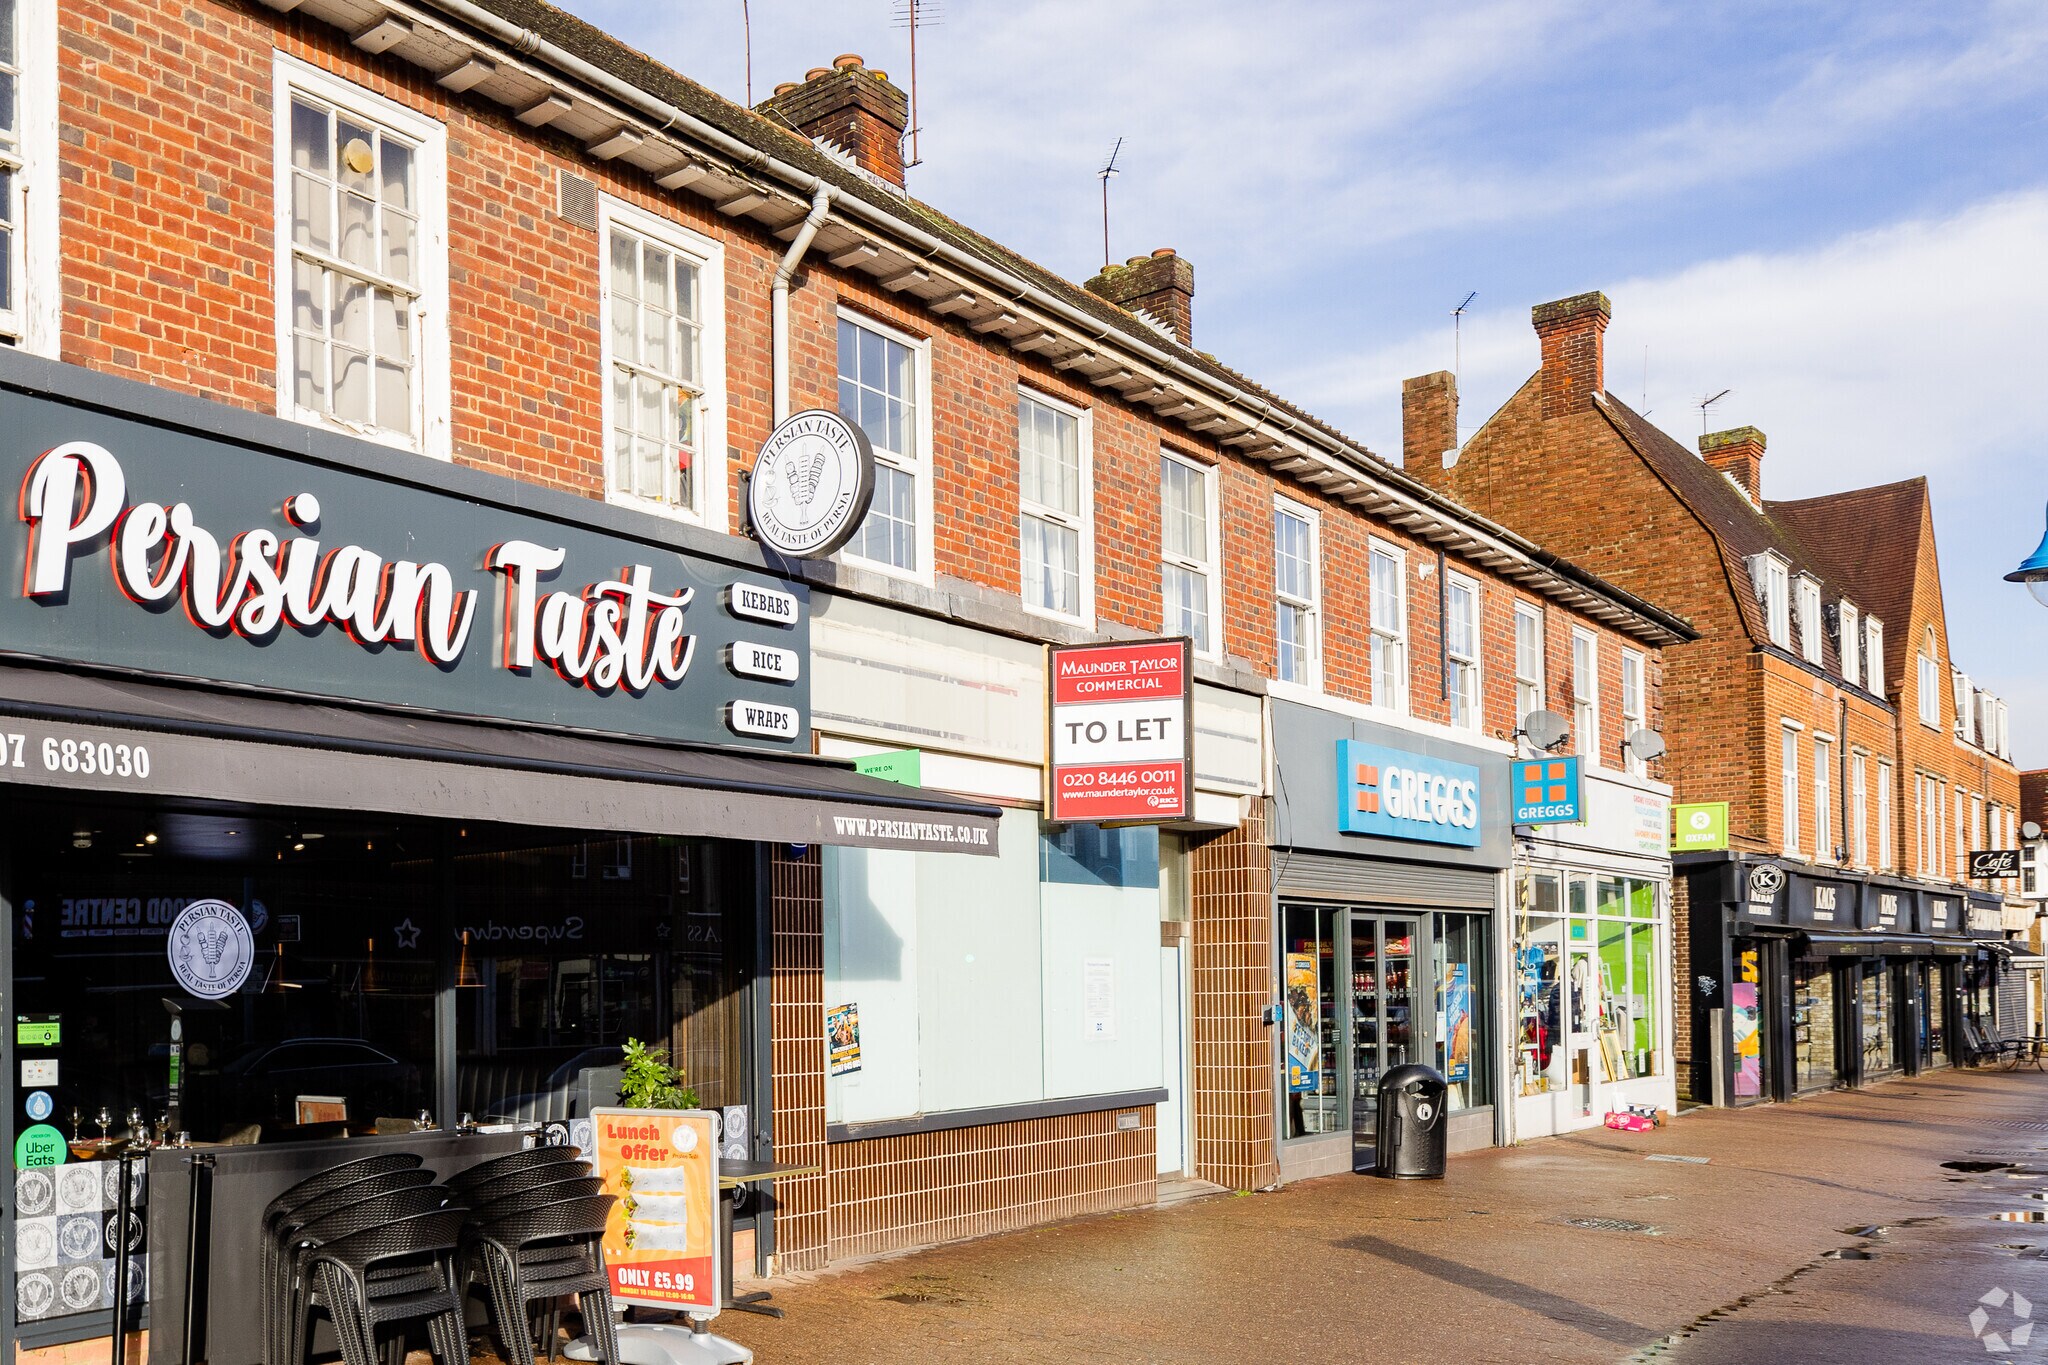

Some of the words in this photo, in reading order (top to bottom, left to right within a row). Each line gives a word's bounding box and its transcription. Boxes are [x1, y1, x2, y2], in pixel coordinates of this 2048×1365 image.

[763, 419, 814, 466] PERSIAN
[816, 419, 851, 454] TASTE
[762, 511, 779, 539] REAL
[780, 531, 809, 545] TASTE
[810, 527, 823, 541] OF
[824, 491, 851, 532] PERSIA
[25, 440, 478, 664] Persian
[488, 539, 697, 691] Taste
[741, 589, 790, 617] KEBABS
[752, 650, 782, 672] RICE
[1060, 660, 1127, 676] MAUNDER
[1130, 657, 1178, 675] TAYLOR
[1076, 677, 1163, 693] COMMERCIAL
[745, 707, 788, 731] WRAPS
[1065, 720, 1108, 745] TO
[1117, 717, 1172, 742] LET
[42, 737, 150, 779] 683030
[864, 766, 882, 774] WE'RE
[1063, 772, 1094, 787] 020
[1098, 770, 1137, 786] 8446
[1141, 769, 1176, 784] 0011
[1062, 785, 1175, 800] www.maundertaylor.co.uk
[1382, 766, 1478, 830] GREGGS
[1518, 804, 1574, 819] GREGGS
[833, 816, 989, 846] WWW.PERSIANTASTE.CO.UK
[1685, 833, 1716, 843] OXFAM
[1974, 852, 2015, 875] Café
[1759, 873, 1774, 886] K
[178, 906, 218, 932] PERSIAN
[219, 907, 246, 936] TASTE
[178, 963, 193, 984] REAL
[194, 979, 217, 991] TASTE
[217, 982, 227, 990] OF
[227, 961, 246, 986] PERSIA
[607, 1124, 660, 1141] Lunch
[25, 1142, 55, 1154] Uber
[621, 1144, 669, 1162] Offer
[26, 1155, 55, 1167] Eats
[617, 1267, 650, 1287] ONLY
[653, 1271, 695, 1292] £5.99
